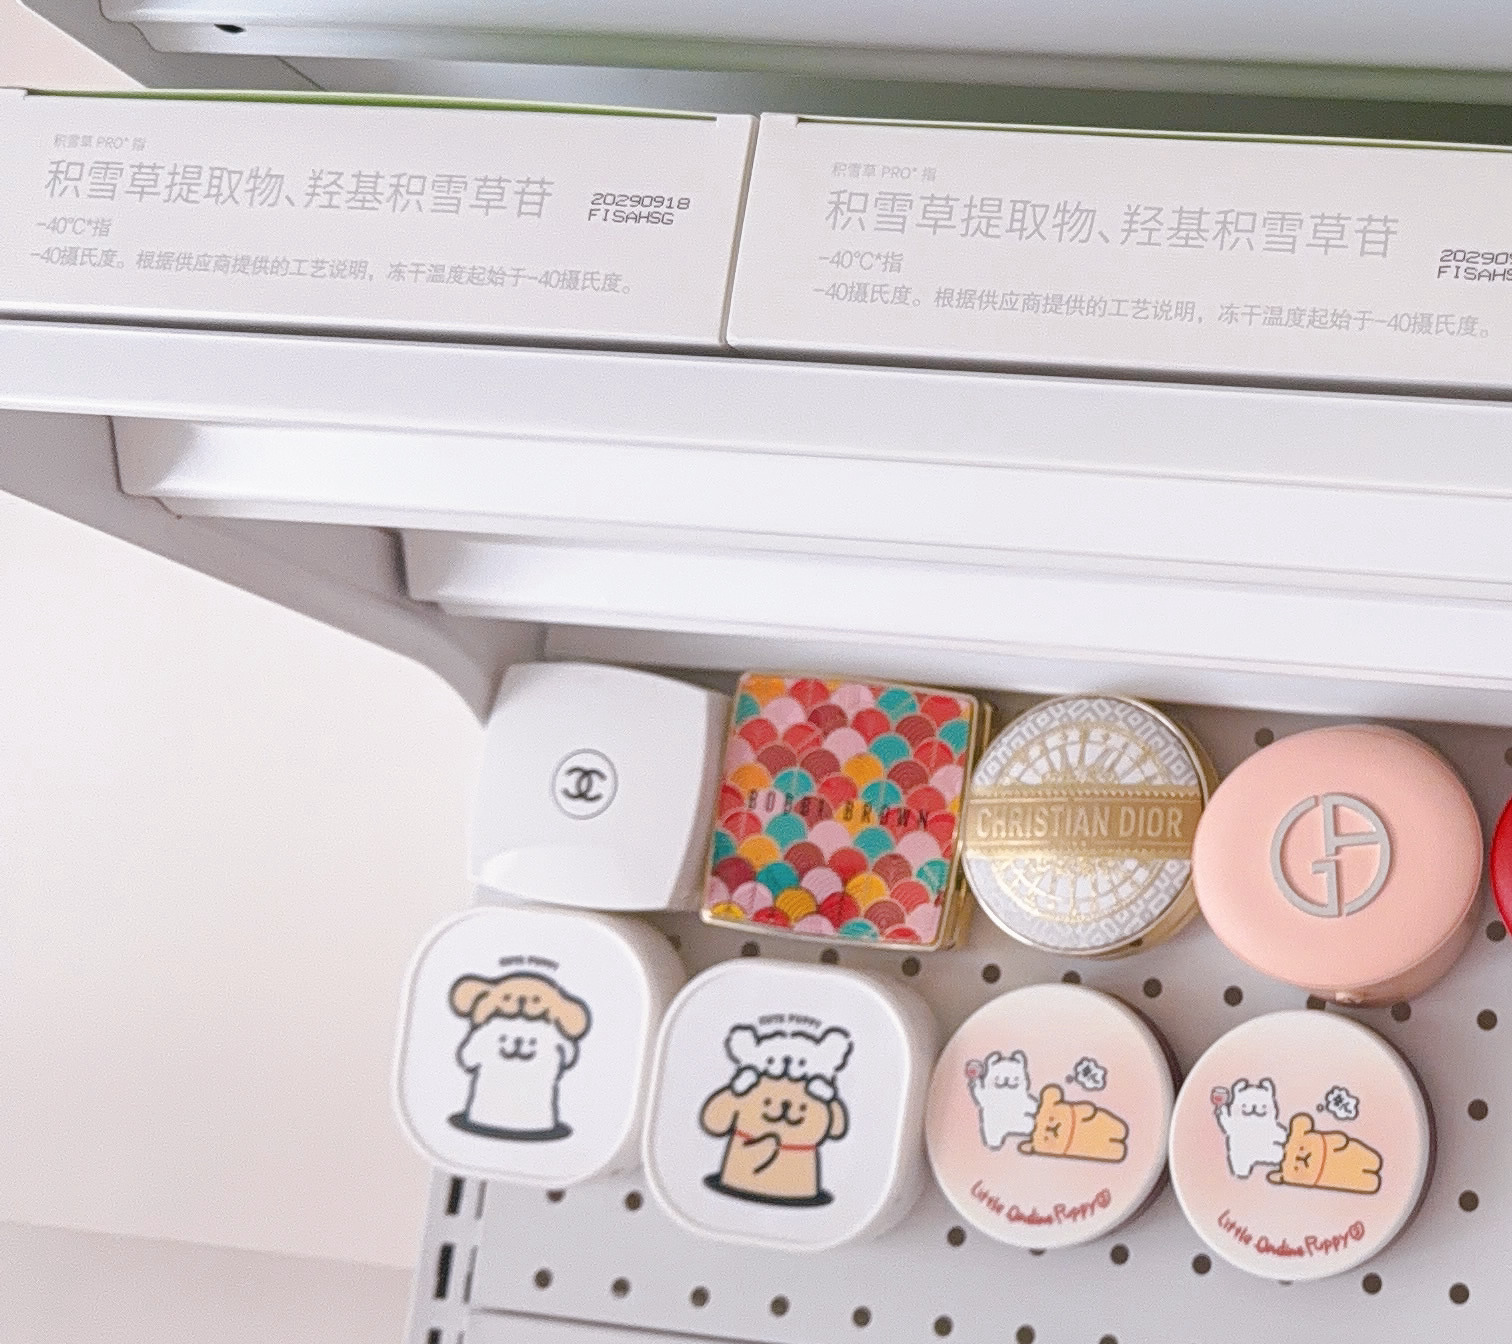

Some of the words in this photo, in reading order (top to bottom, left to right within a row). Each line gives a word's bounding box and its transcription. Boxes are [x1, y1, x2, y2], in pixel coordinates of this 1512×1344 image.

[53, 133, 93, 148] 积雪草
[832, 162, 876, 179] 积雪草
[921, 166, 936, 182] 指
[591, 193, 690, 210] 20290918
[976, 806, 1110, 838] CHRISTIAN
[1119, 807, 1184, 837] DIOR
